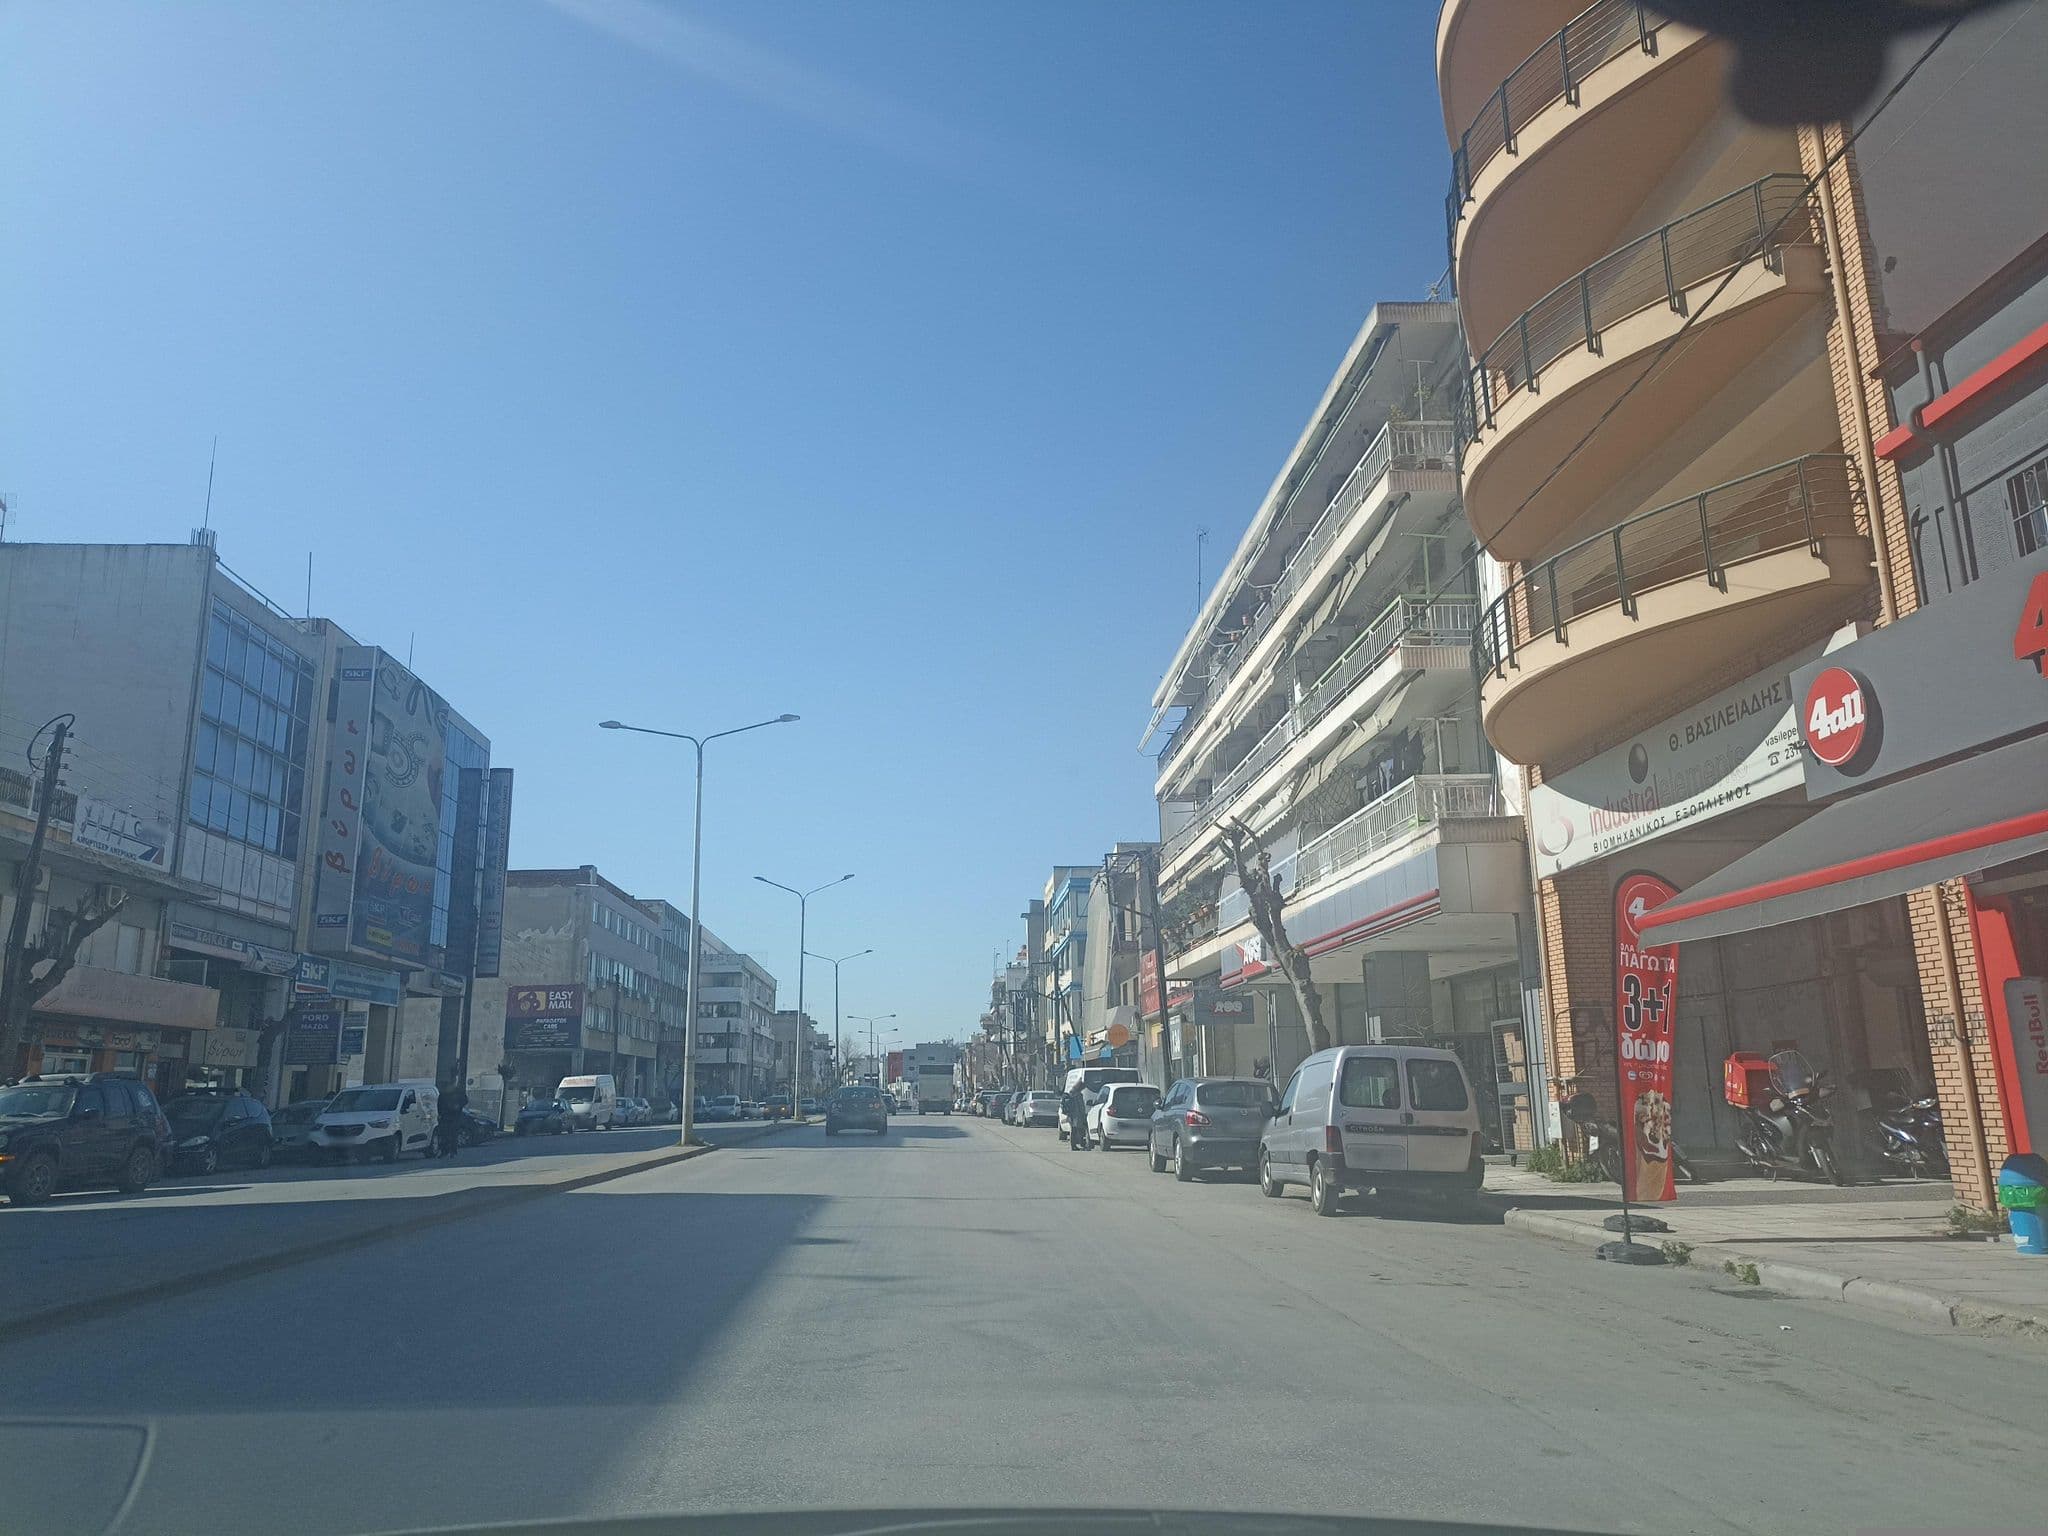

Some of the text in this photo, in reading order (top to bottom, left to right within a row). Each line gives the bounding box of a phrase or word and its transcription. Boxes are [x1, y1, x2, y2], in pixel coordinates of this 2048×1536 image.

[344, 669, 370, 678] SKF
[1669, 682, 1783, 751] Θ. ΒΑΣΙΛΕΙΑΔΗΣ
[1809, 689, 1865, 740] 4all
[1765, 727, 1799, 747] vasilepe
[1593, 783, 1751, 853] ΒΙΟΜΗΧΑΝΙΚΟΣ ΕΞΟΠΛΙΣΜΟΣ
[319, 916, 346, 924] SKF
[301, 961, 328, 981] SKF
[1620, 951, 1675, 974] ΠΑΓΩΤΑ
[548, 1000, 573, 1010] MAIL
[549, 991, 574, 1000] EASY
[1622, 973, 1671, 1034] 3+1
[302, 1013, 329, 1022] FORD
